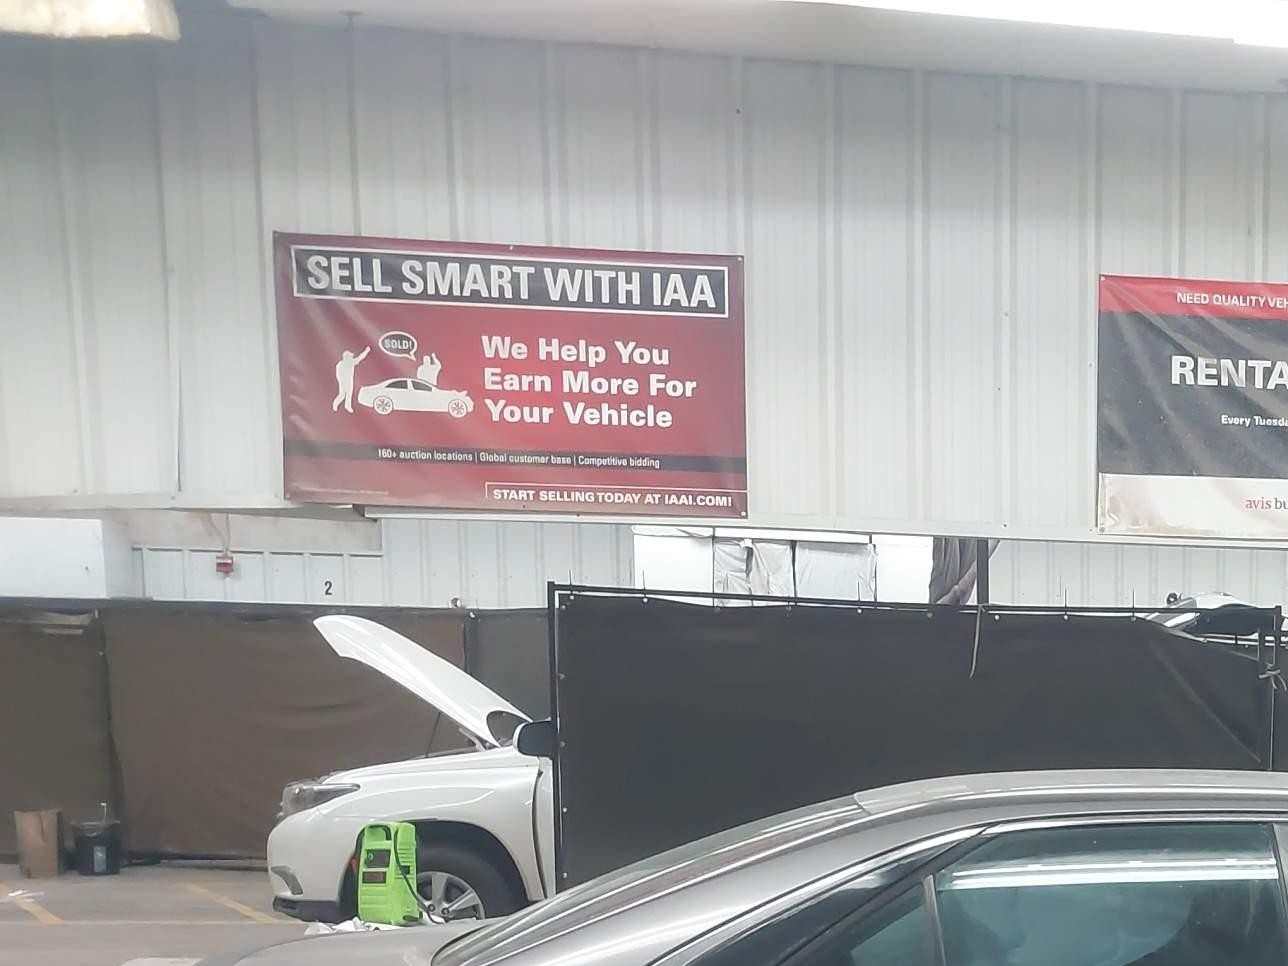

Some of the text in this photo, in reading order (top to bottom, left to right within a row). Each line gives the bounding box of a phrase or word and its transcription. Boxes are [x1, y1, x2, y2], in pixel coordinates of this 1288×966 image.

[307, 255, 717, 308] SELL SMART WITH IAA
[1177, 292, 1210, 304] NEED
[1213, 294, 1266, 308] QUALITY
[384, 339, 412, 349] SOLD!
[481, 335, 669, 368] We Help You
[484, 368, 697, 398] Earn More For
[484, 399, 673, 428] Your Vehicle
[1221, 415, 1251, 429] Every
[378, 448, 397, 458] 160+
[400, 450, 432, 460] auction
[434, 450, 473, 461] locations
[480, 452, 507, 462] Global
[509, 454, 549, 464] customer
[551, 454, 571, 465] base
[578, 455, 627, 467] Competitive
[629, 457, 660, 469] bidding
[493, 489, 732, 507] START SELLING TODAY AT IAAI.COM!
[1245, 498, 1272, 510] avis
[324, 580, 333, 596] 2
